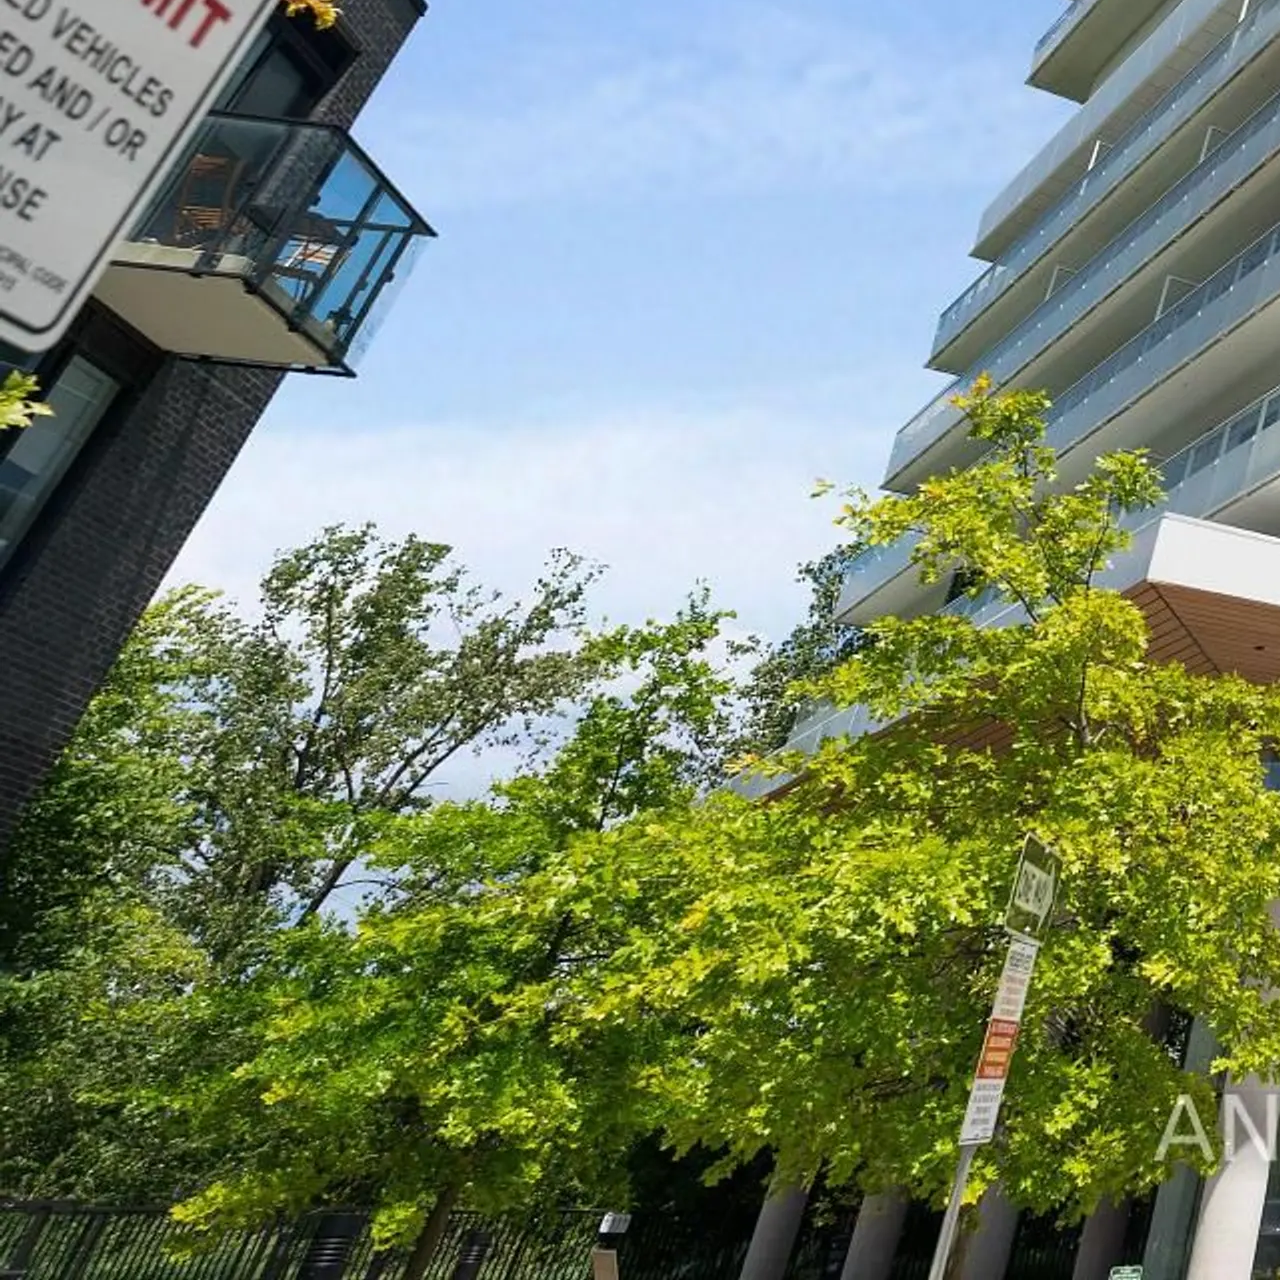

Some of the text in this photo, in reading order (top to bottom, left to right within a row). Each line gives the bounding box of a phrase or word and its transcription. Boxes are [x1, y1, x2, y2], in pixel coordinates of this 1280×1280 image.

[51, 7, 175, 118] VEHICLES
[11, 122, 62, 161] AT
[26, 65, 94, 121] AND
[104, 117, 148, 162] OR
